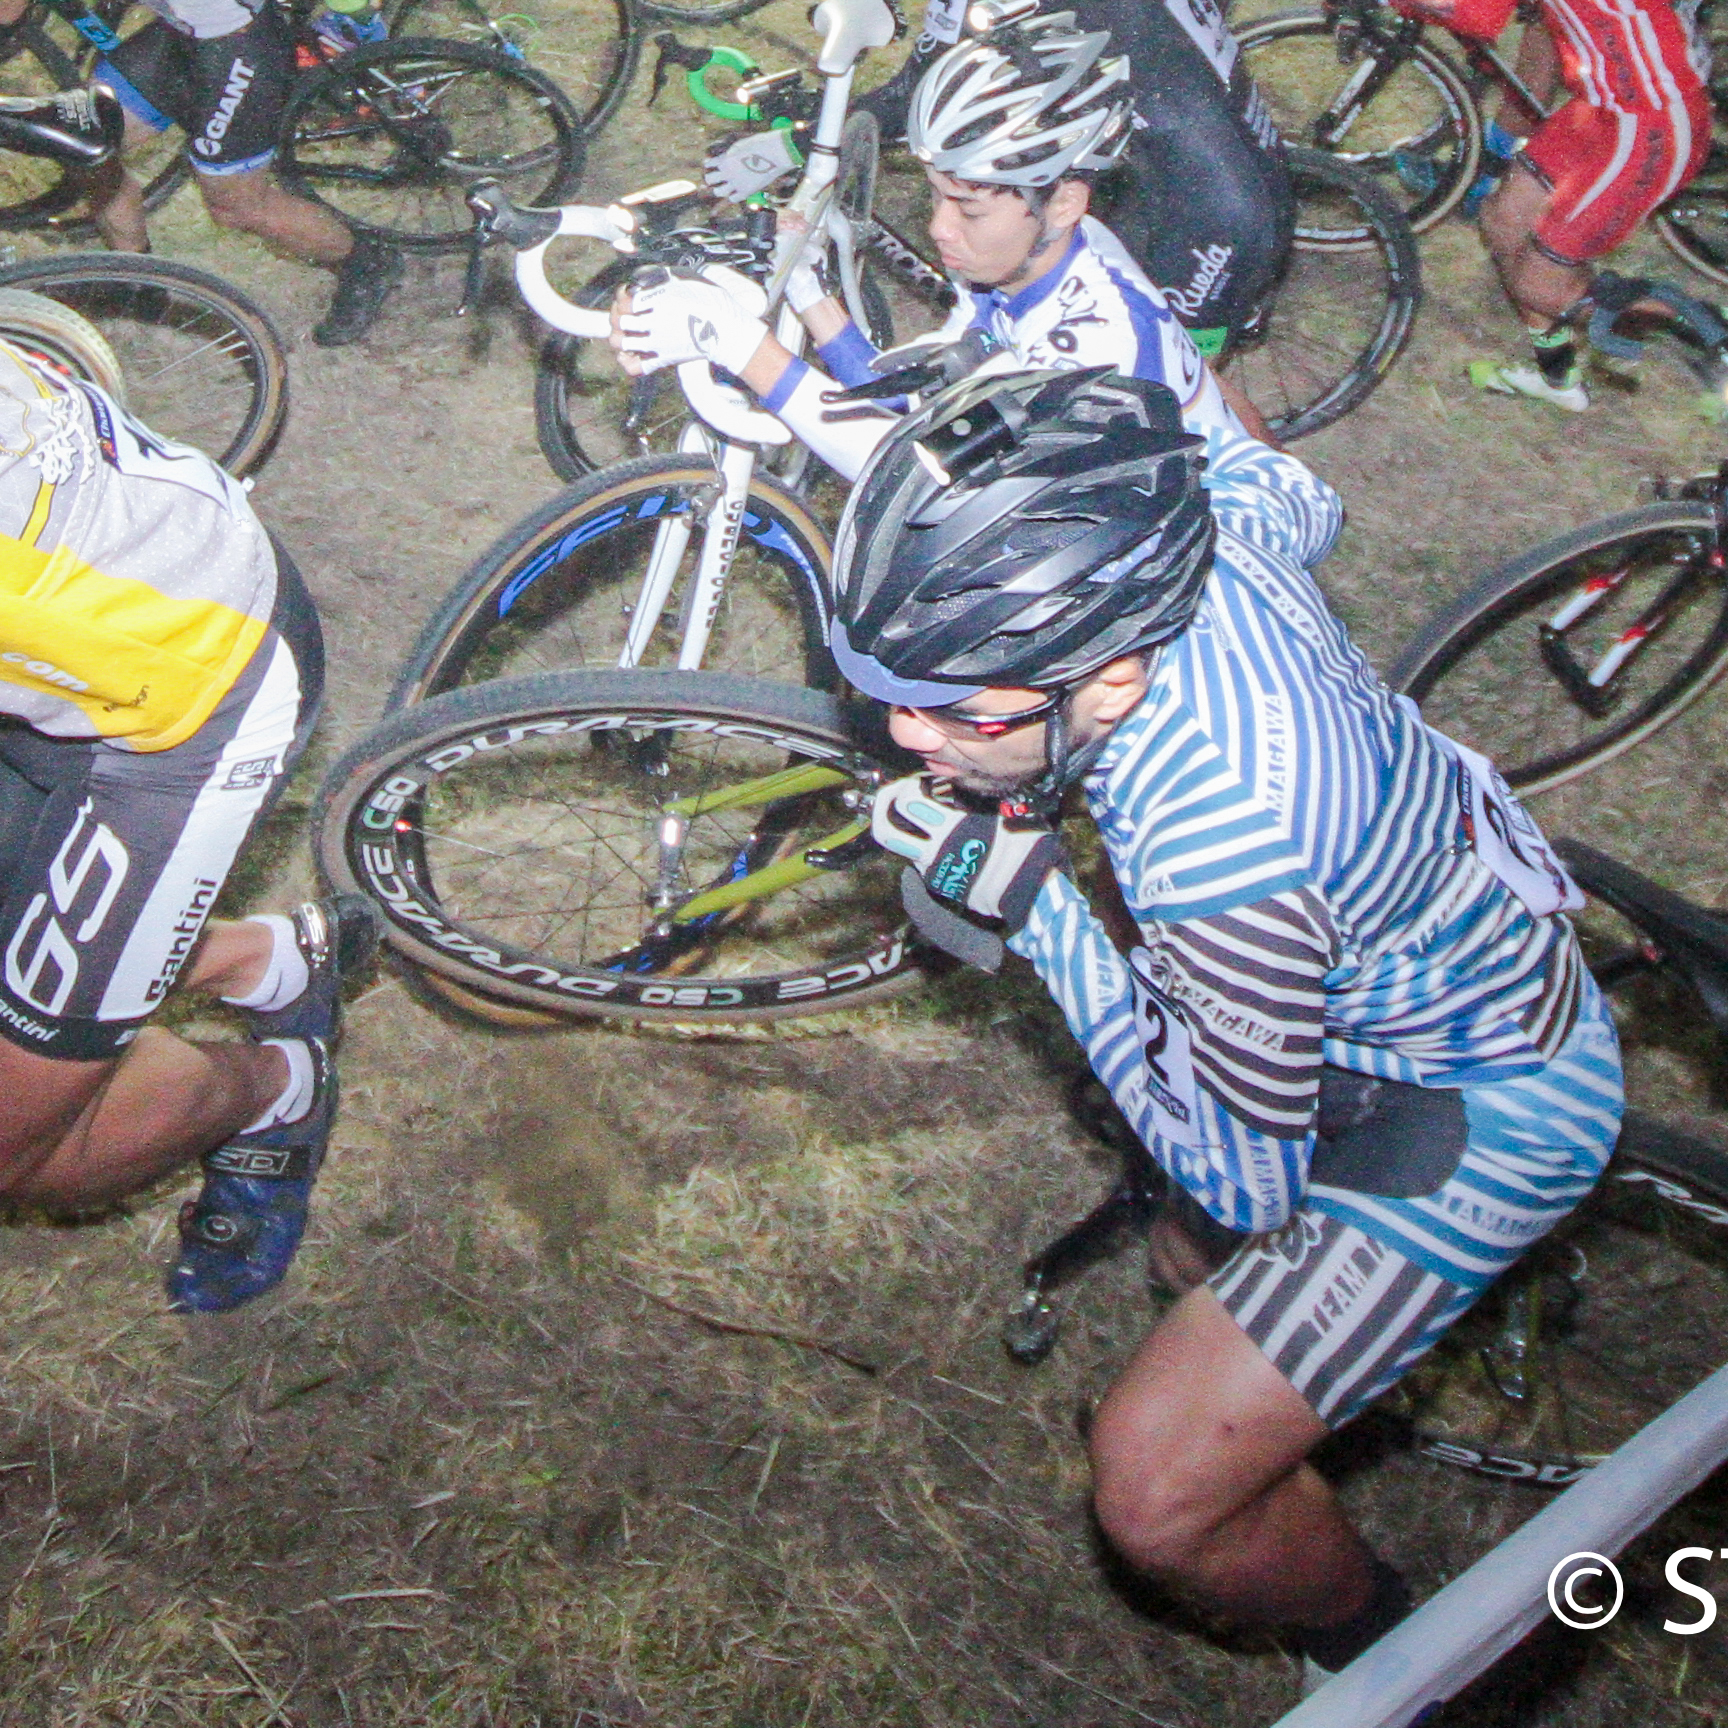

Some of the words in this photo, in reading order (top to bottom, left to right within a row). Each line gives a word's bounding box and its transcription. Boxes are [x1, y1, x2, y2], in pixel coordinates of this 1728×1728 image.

[205, 58, 254, 139] GIANT
[1160, 243, 1233, 317] Rueda
[425, 714, 845, 772] DURA-ACE
[362, 776, 419, 830] C50
[144, 876, 218, 1004] Santini
[362, 843, 620, 997] DURA-ACE
[639, 987, 743, 1007] C50
[1144, 998, 1171, 1087] 2
